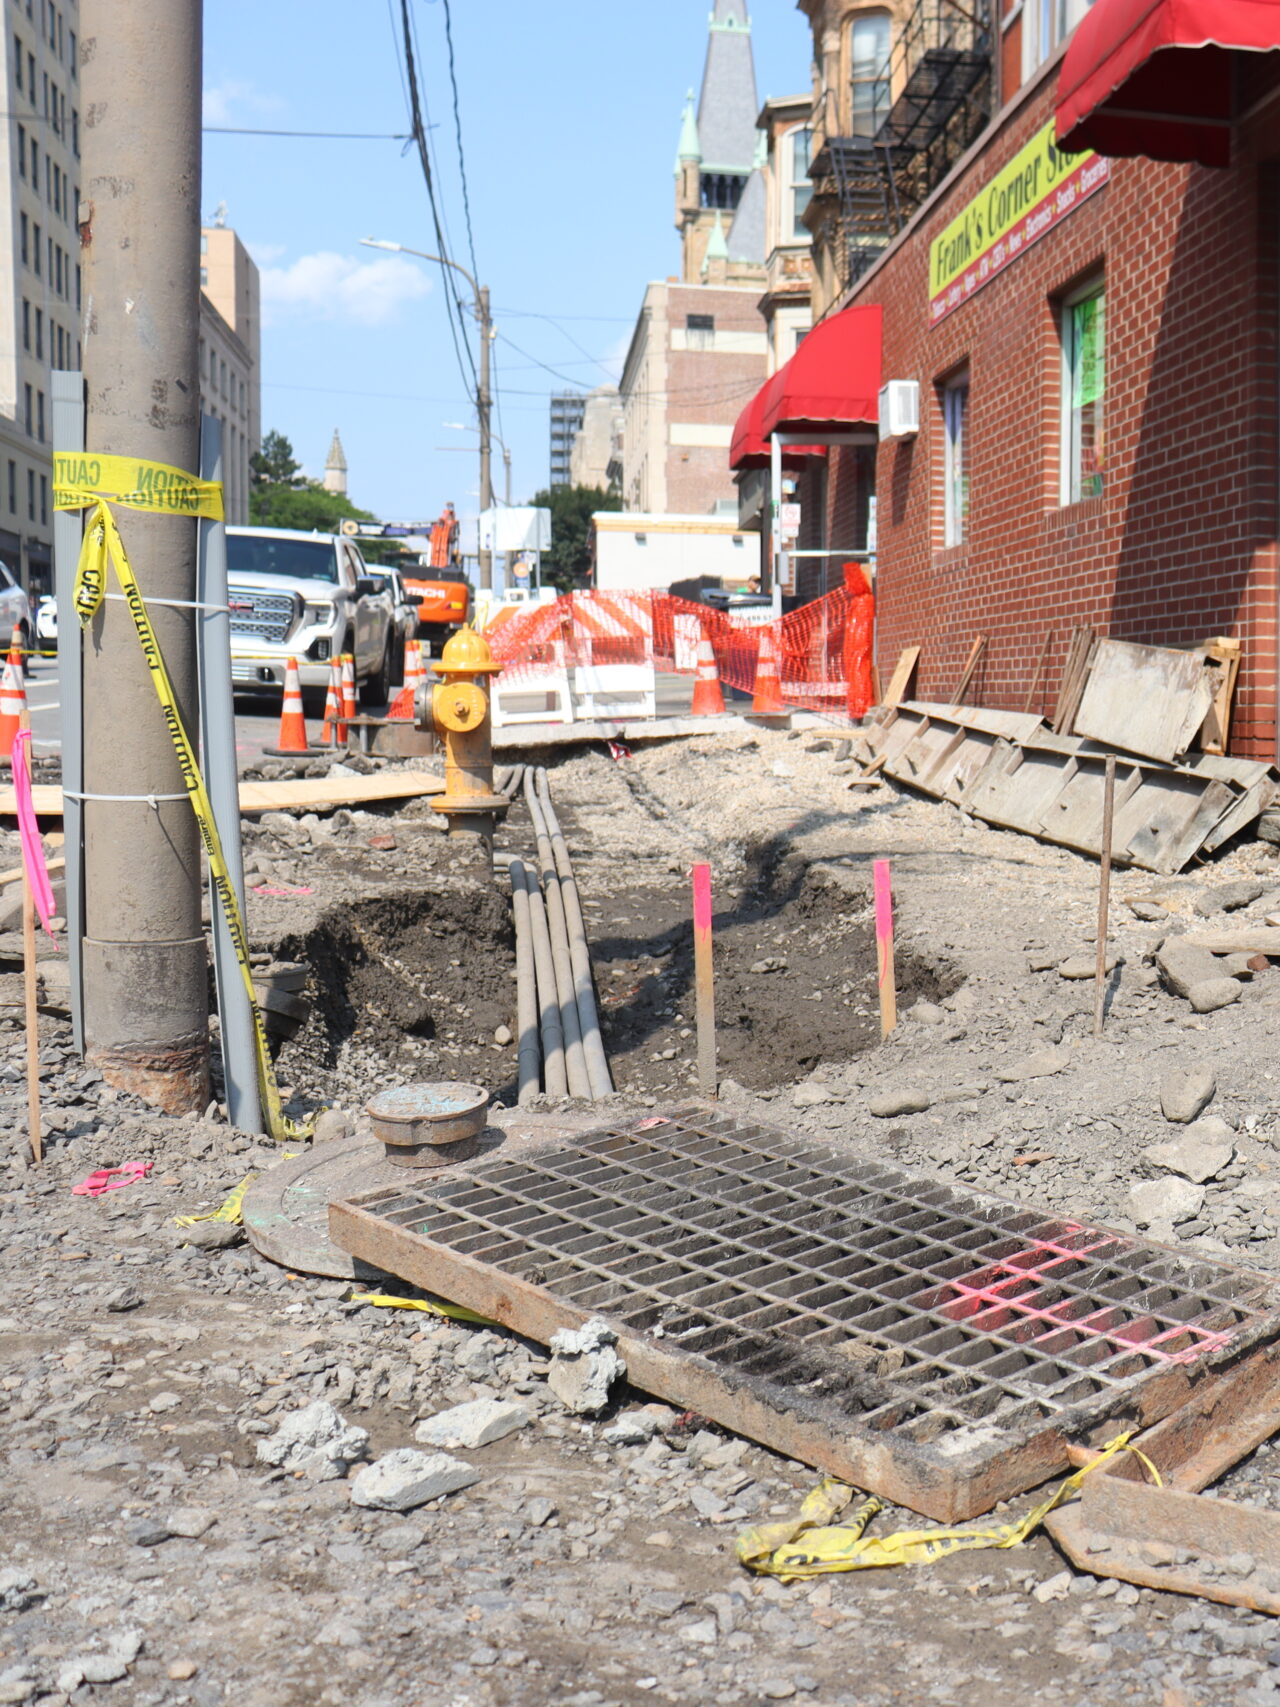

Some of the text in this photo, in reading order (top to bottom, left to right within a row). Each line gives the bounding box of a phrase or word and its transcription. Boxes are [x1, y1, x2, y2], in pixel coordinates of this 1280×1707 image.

[937, 207, 983, 287] Frank's
[988, 154, 1042, 237] Corner
[406, 586, 445, 599] ITACHI
